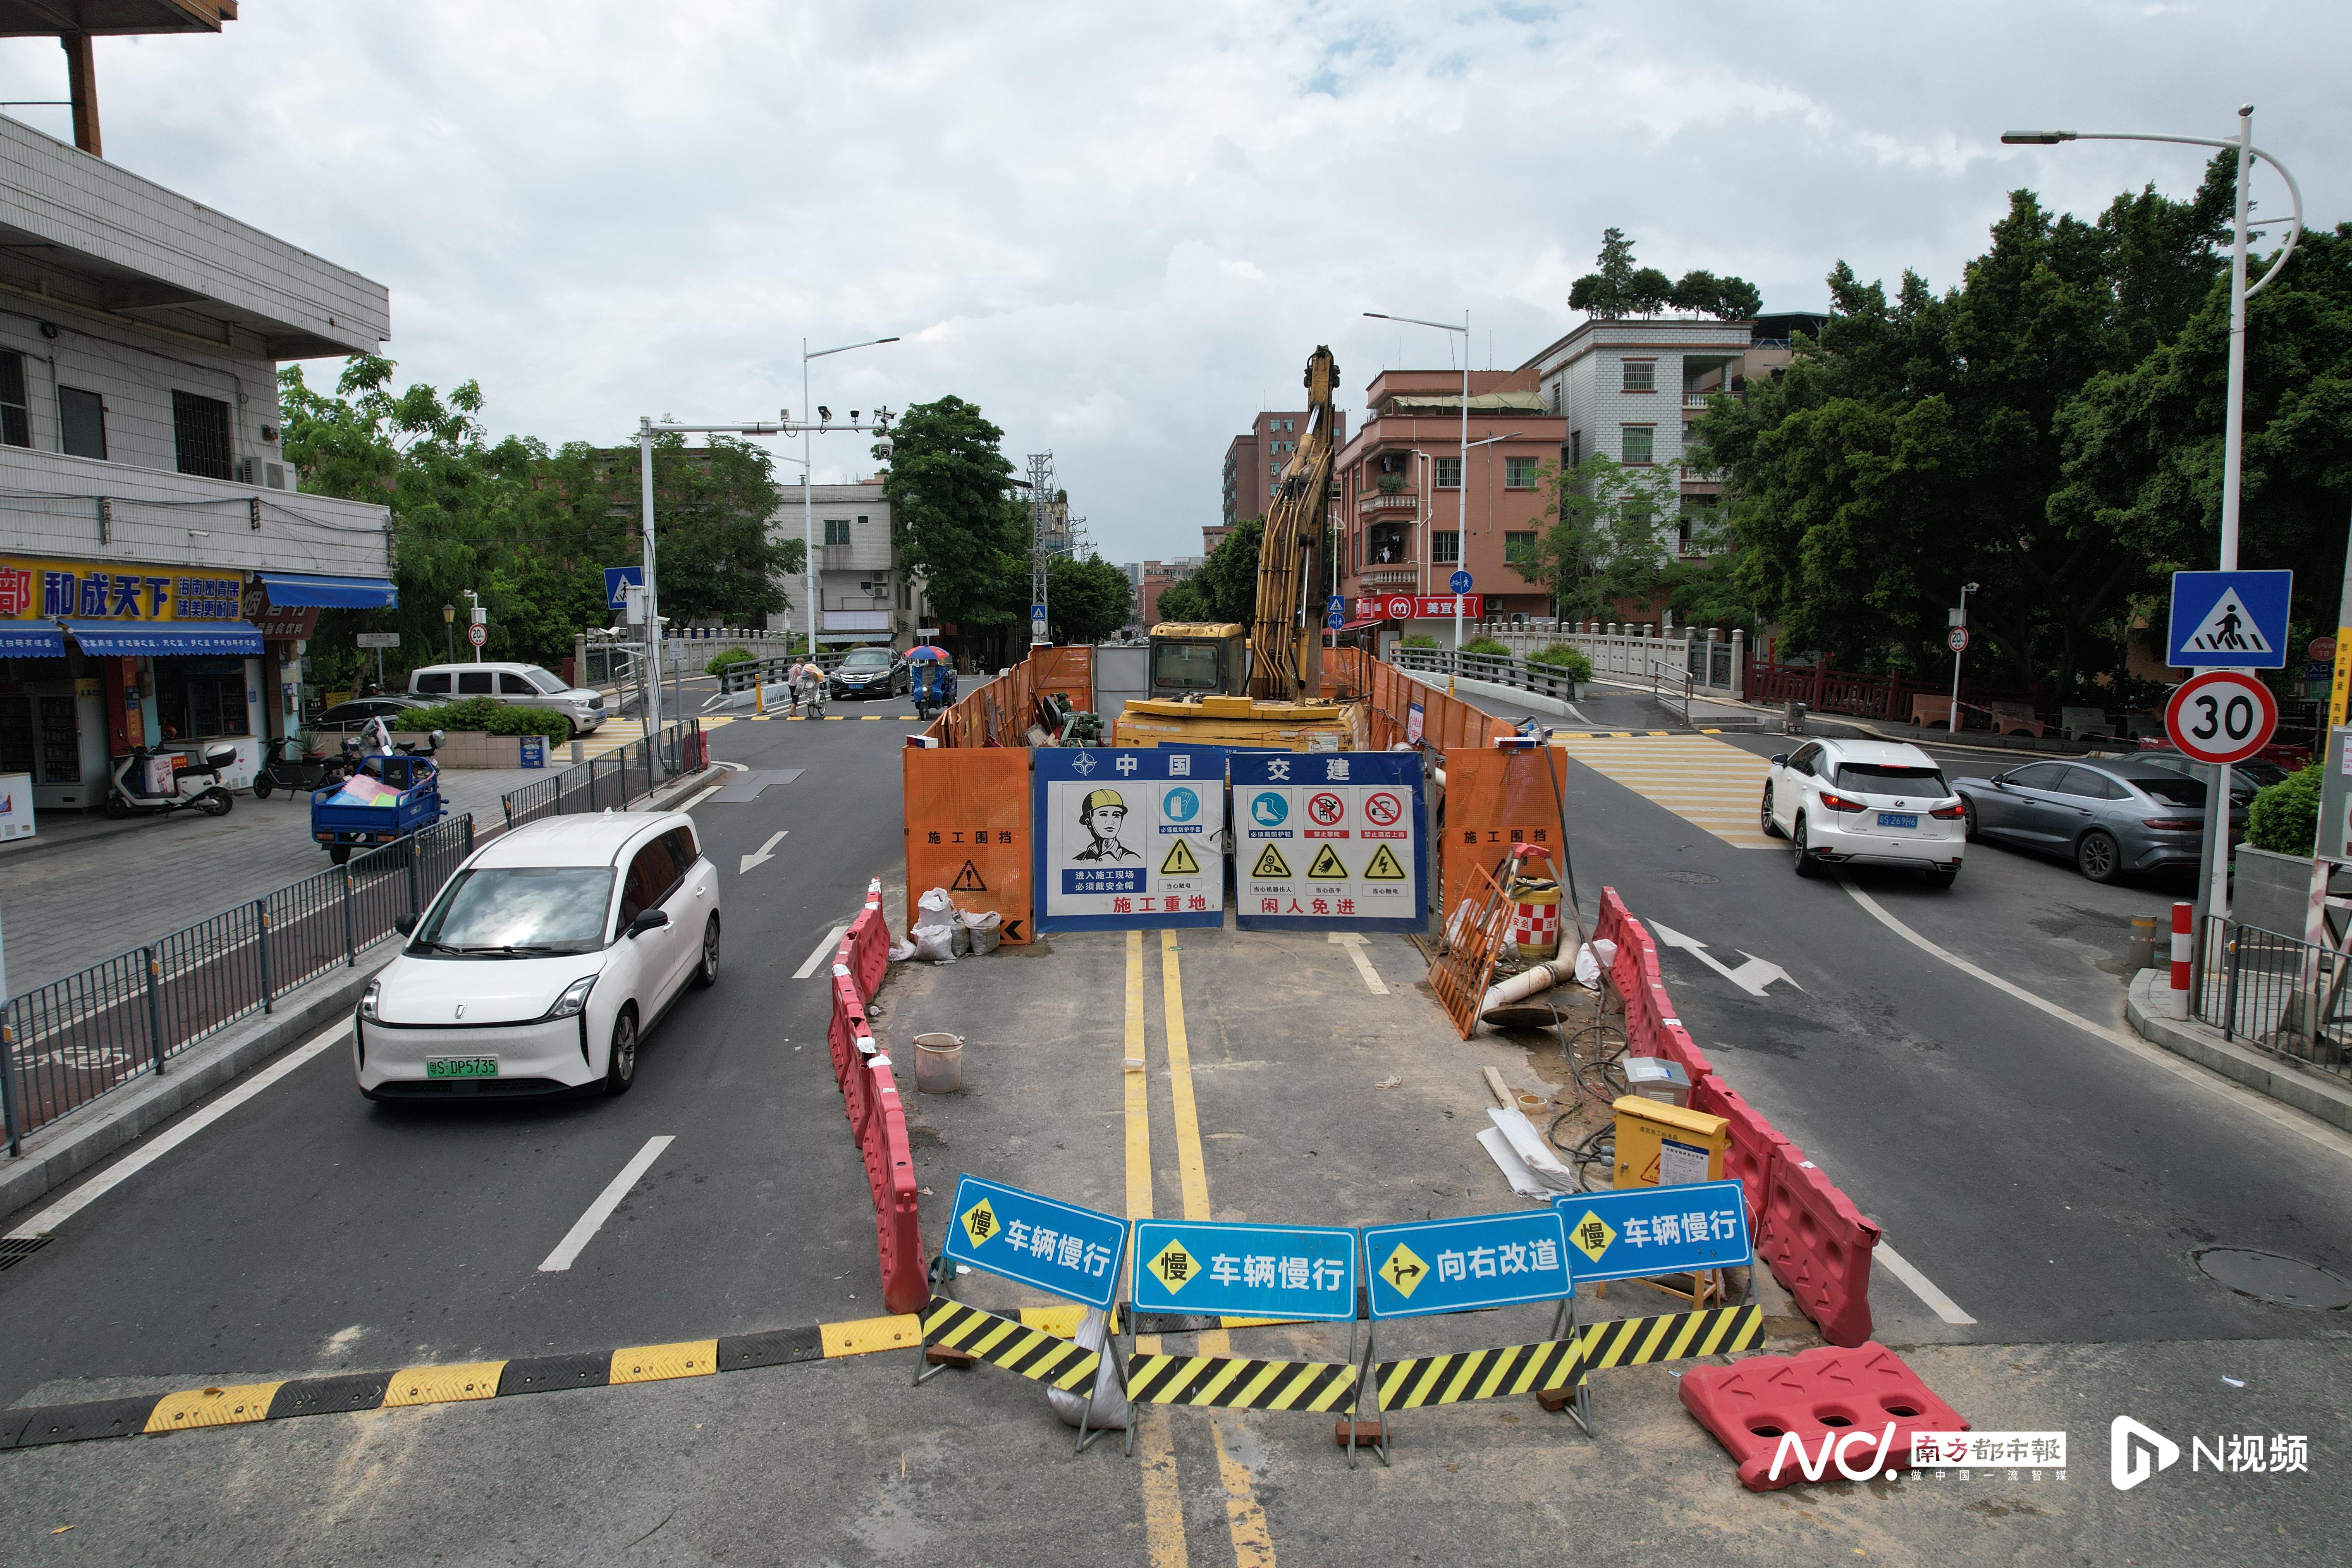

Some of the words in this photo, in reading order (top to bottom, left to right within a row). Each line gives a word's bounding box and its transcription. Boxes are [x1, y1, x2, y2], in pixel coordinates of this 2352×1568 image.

[0, 567, 32, 616] 部
[44, 571, 171, 617] 和成天下
[178, 577, 240, 598] 海南嫩青果
[177, 599, 239, 618] 味美更耐嚼
[472, 629, 481, 638] 20
[1952, 632, 1961, 643] 20
[2192, 695, 2253, 740] 30
[1116, 753, 1191, 777] 中国
[1268, 758, 1350, 781] 交建
[927, 830, 1012, 845] 施工围挡
[1250, 830, 1292, 838] 必须戴防护鞋
[1364, 830, 1405, 839] 禁止酒后上岗
[1464, 829, 1547, 844] 施工围挡
[1075, 870, 1135, 880] 进入施工现场
[1075, 881, 1134, 891] 必须戴安全帽
[1113, 894, 1207, 913] 施工重地
[1261, 897, 1356, 915] 闲人免进
[1513, 917, 1528, 928] 安全
[1580, 1222, 1605, 1251] 慢
[1623, 1210, 1736, 1249] 车辆慢行
[971, 1208, 992, 1239] 慢
[1004, 1219, 1112, 1278] 车辆慢行
[1437, 1239, 1559, 1283] 向右改道
[1161, 1252, 1188, 1282] 慢
[1209, 1253, 1345, 1292] 车辆慢行
